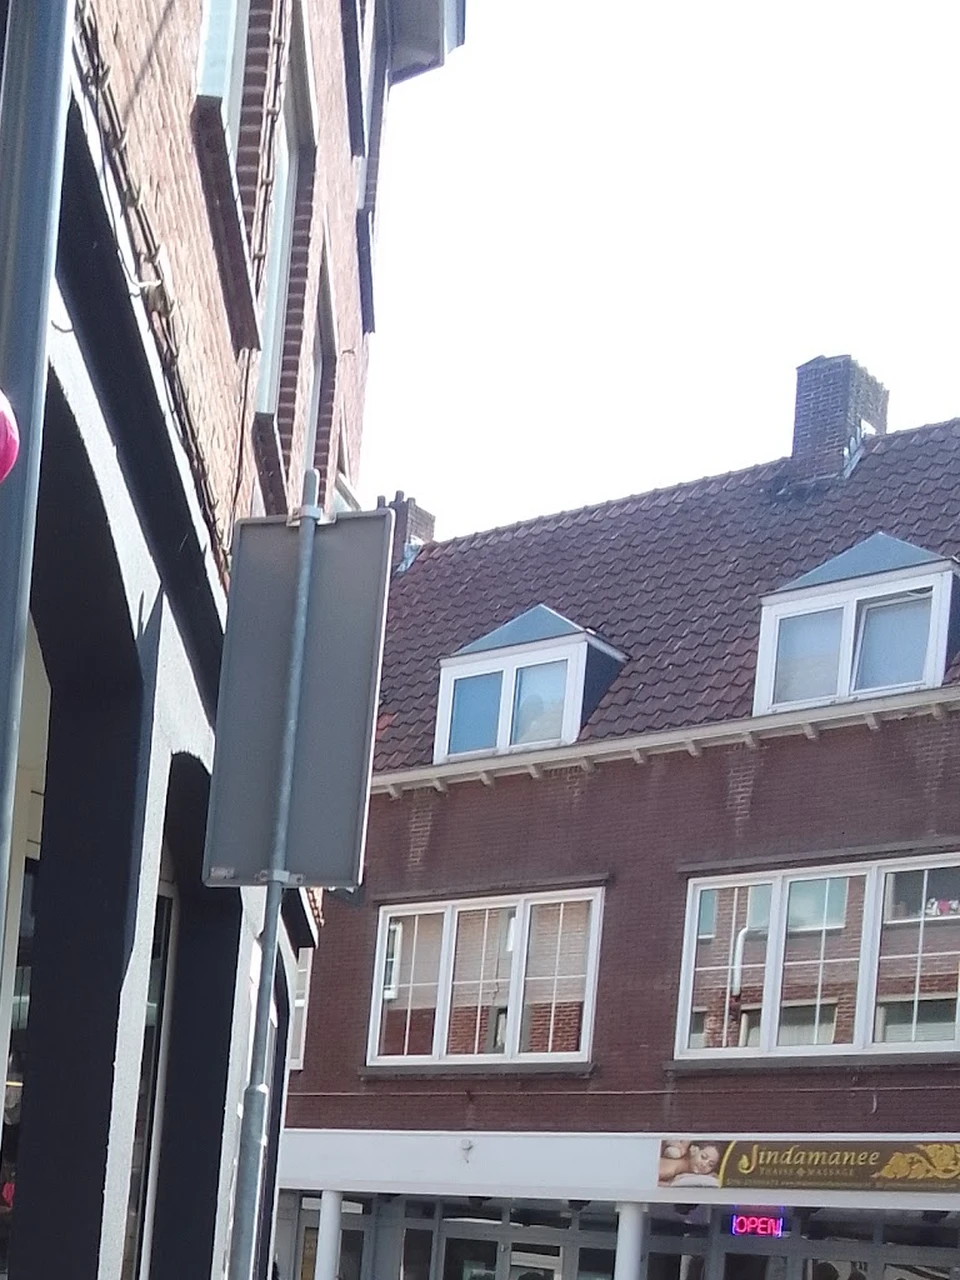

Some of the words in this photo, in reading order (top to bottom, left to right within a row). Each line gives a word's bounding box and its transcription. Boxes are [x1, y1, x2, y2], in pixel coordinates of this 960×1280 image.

[738, 1144, 880, 1174] Jindamanee
[807, 1167, 854, 1177] MASSAGE
[736, 1216, 781, 1236] OPEN
